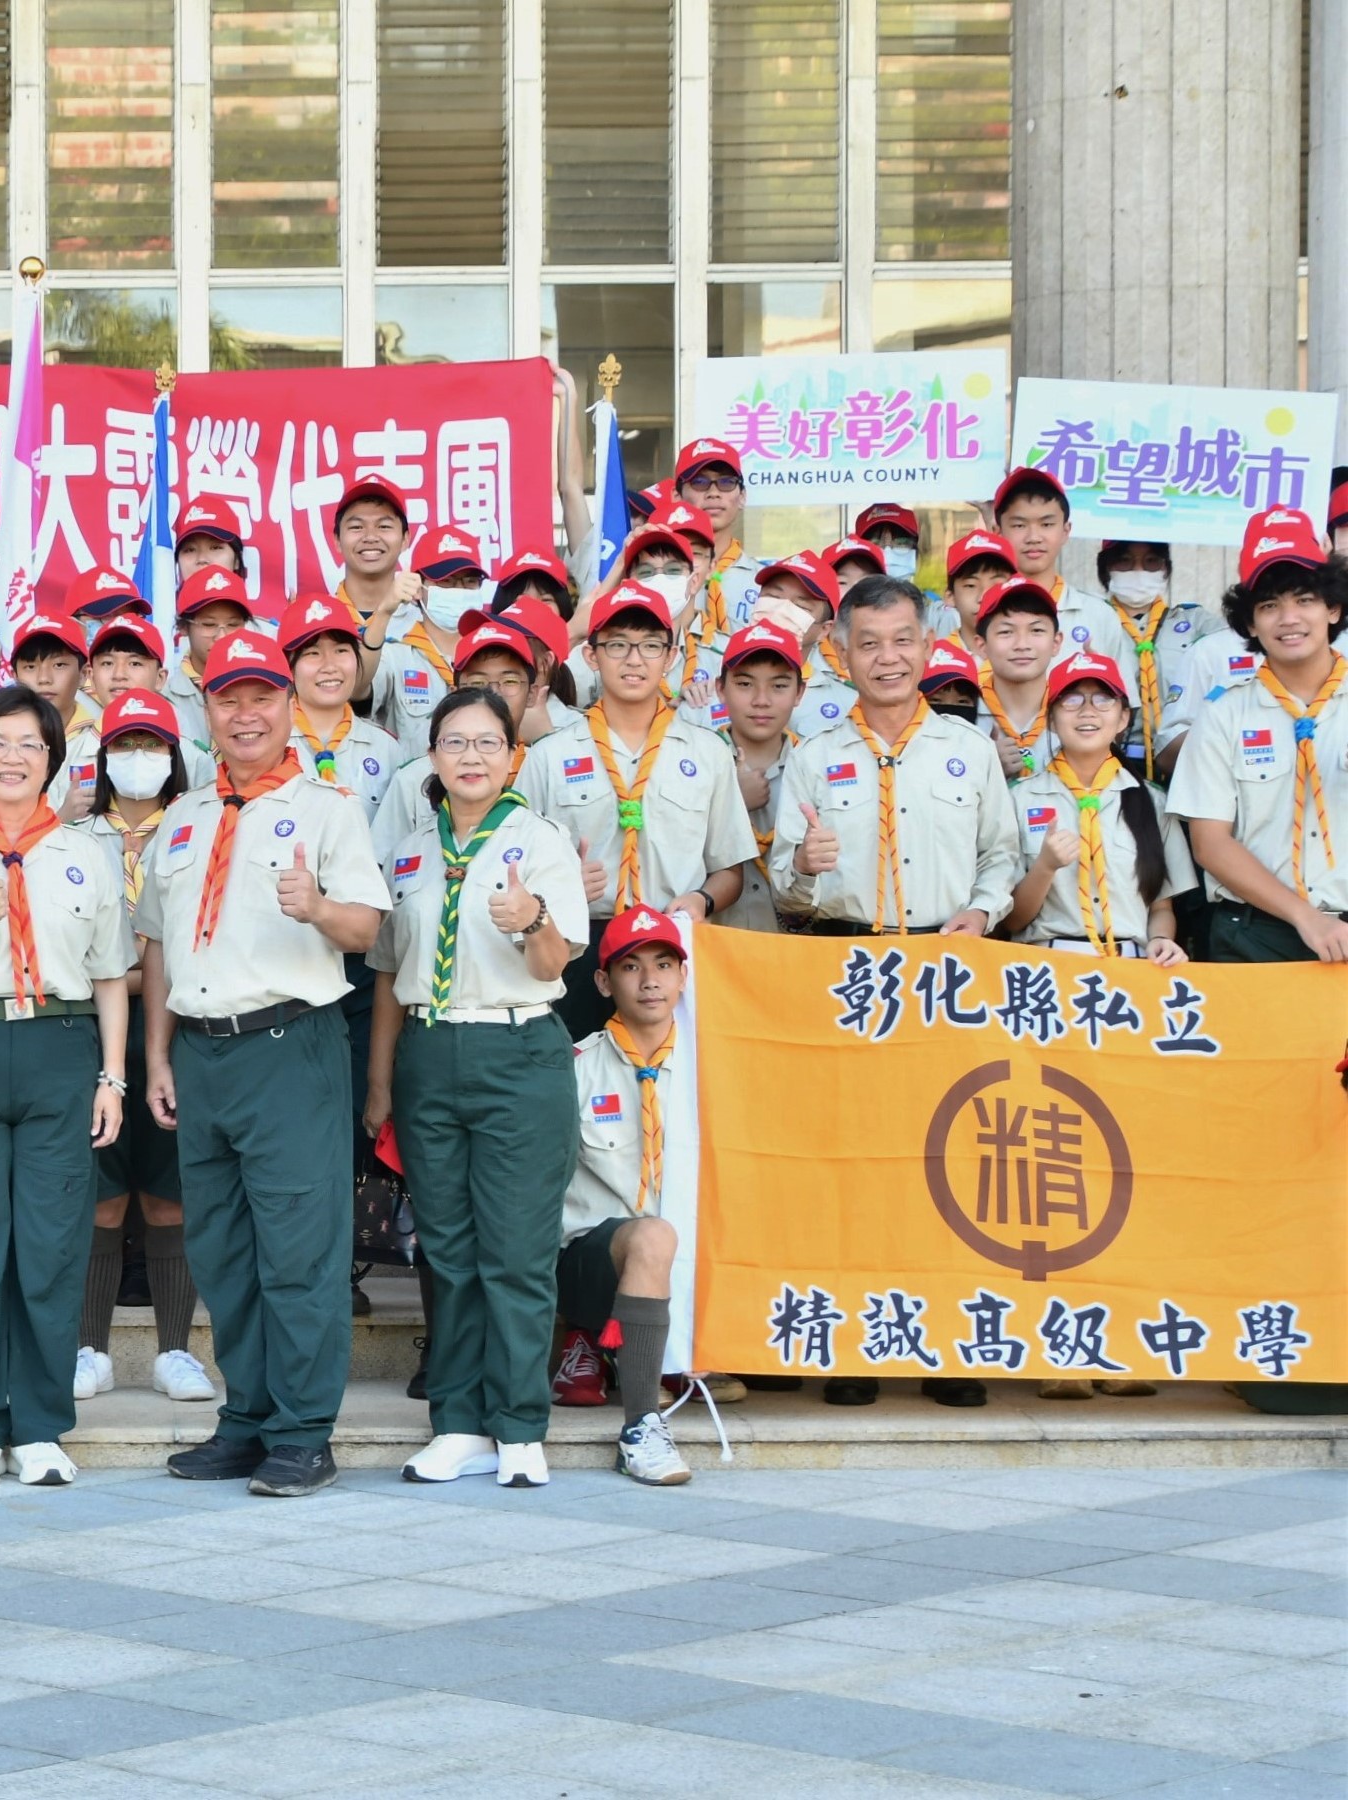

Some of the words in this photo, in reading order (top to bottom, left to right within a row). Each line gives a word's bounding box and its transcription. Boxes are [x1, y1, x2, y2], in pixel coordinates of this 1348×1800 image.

[723, 390, 980, 461] 美好彰化
[1030, 419, 1309, 509] 希望城市
[748, 469, 855, 485] CHANGHUA
[864, 467, 940, 482] COUNTY
[830, 947, 1220, 1054] 彰化縣私立
[972, 1096, 1089, 1230] 精
[767, 1284, 1310, 1377] 精誠高級中學
